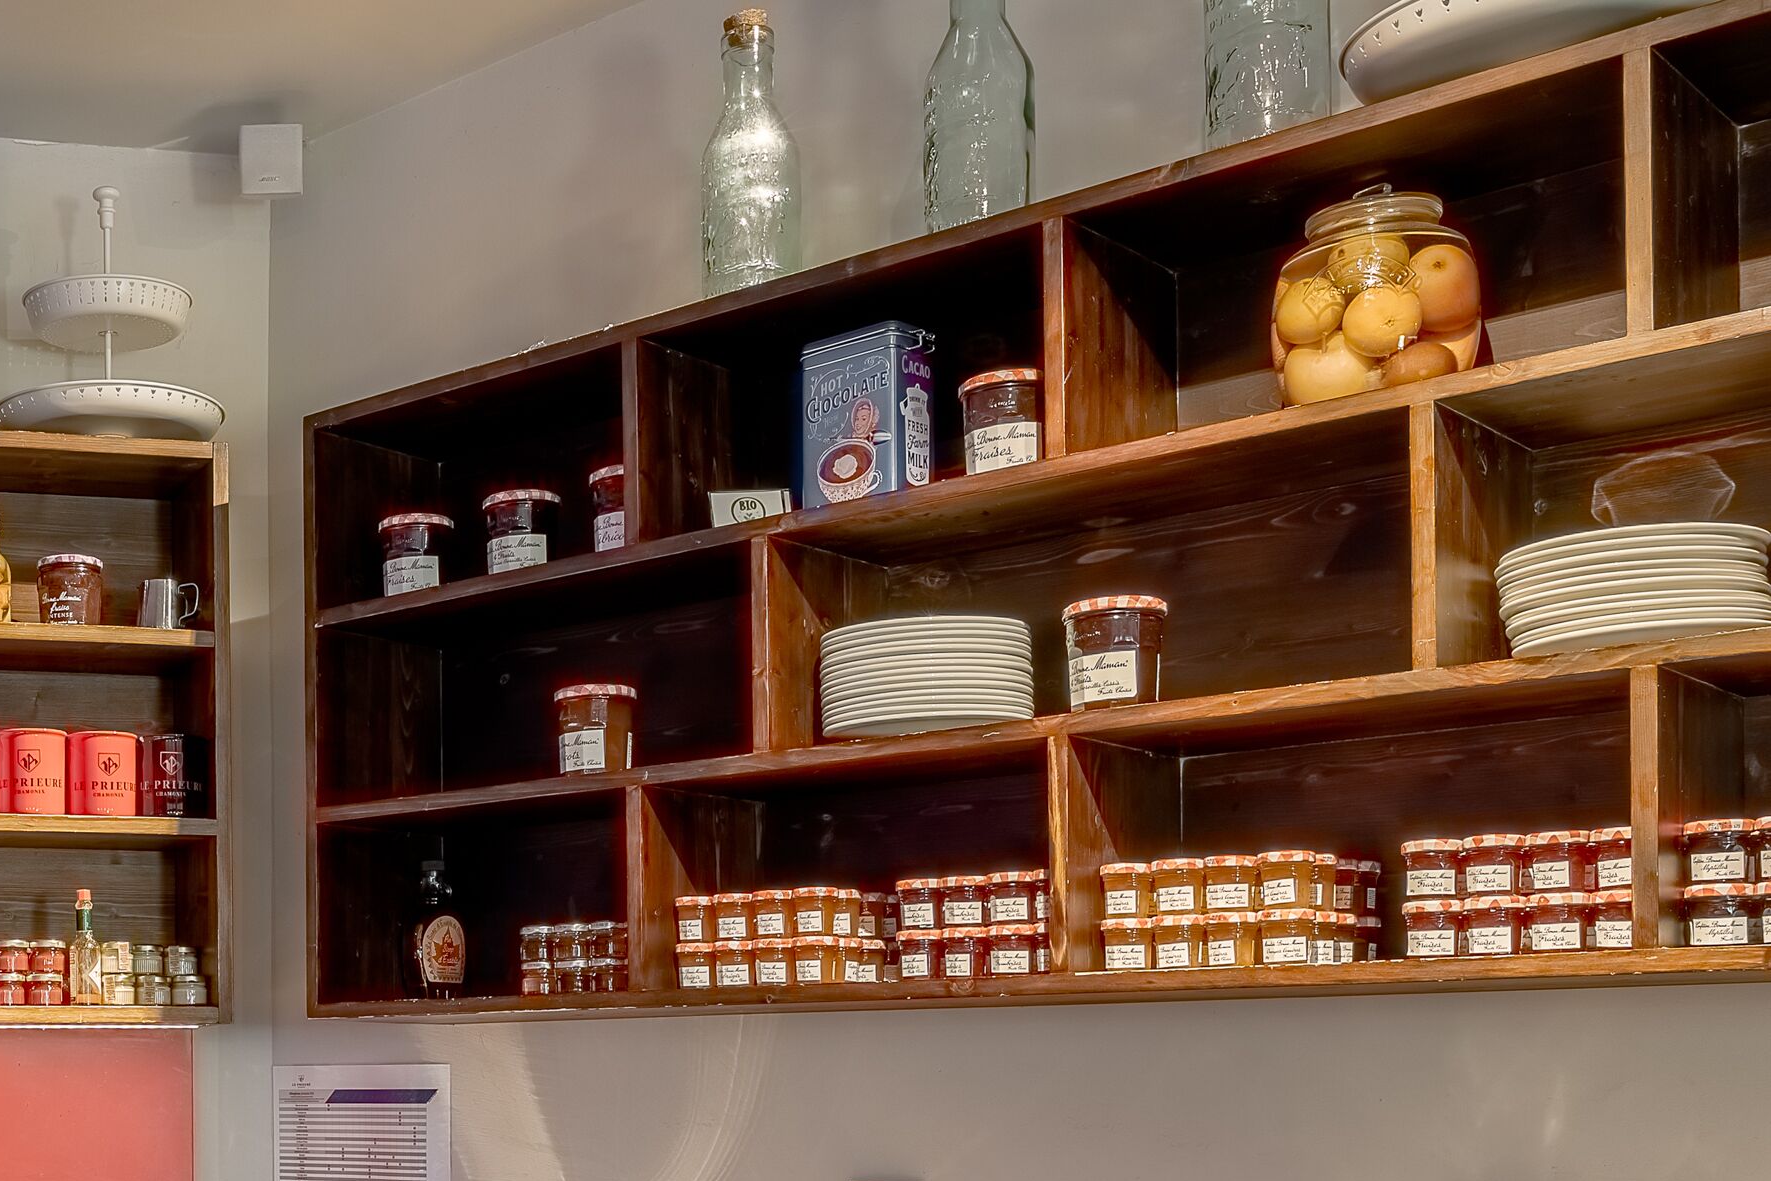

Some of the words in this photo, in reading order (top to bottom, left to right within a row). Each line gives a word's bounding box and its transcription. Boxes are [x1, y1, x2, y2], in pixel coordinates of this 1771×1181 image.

[902, 355, 931, 380] CACAO
[820, 375, 843, 397] HOT
[806, 371, 889, 424] CHOCOLATE
[907, 419, 929, 436] FRESH
[975, 430, 1002, 446] Bonne
[1003, 425, 1036, 440] Maman
[907, 434, 929, 450] Farm
[907, 451, 928, 469] MILK
[973, 447, 1014, 463] Fraises
[739, 500, 758, 511] BIO
[1090, 655, 1129, 671] Maman
[74, 782, 85, 793] LE
[140, 781, 151, 793] LE
[1701, 863, 1728, 872] Myrtilles
[1706, 929, 1733, 937] Myrtilles
